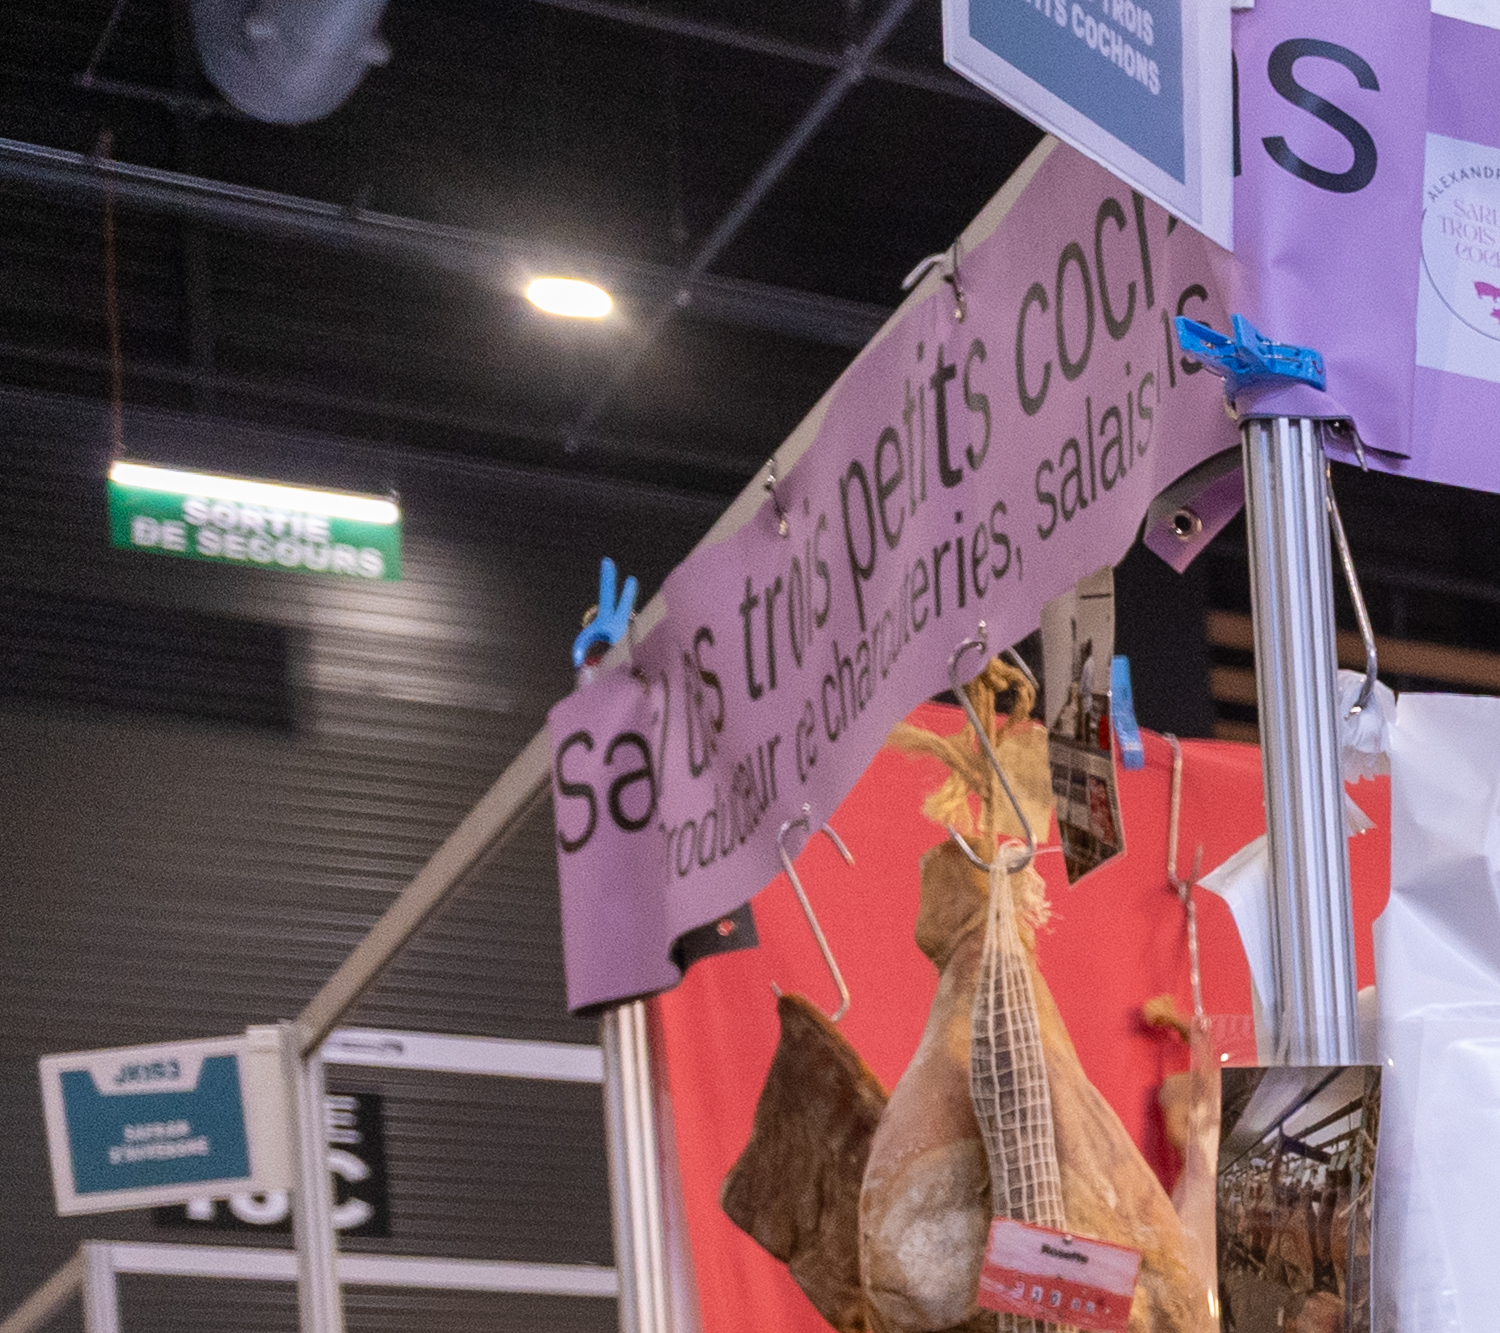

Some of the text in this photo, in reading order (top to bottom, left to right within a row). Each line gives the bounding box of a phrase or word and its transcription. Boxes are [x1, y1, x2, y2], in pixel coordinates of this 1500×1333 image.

[1072, 5, 1160, 95] COCHONS
[1438, 214, 1496, 247] TROIS
[131, 515, 385, 579] DE SECOURS
[182, 497, 330, 544] SORTIE
